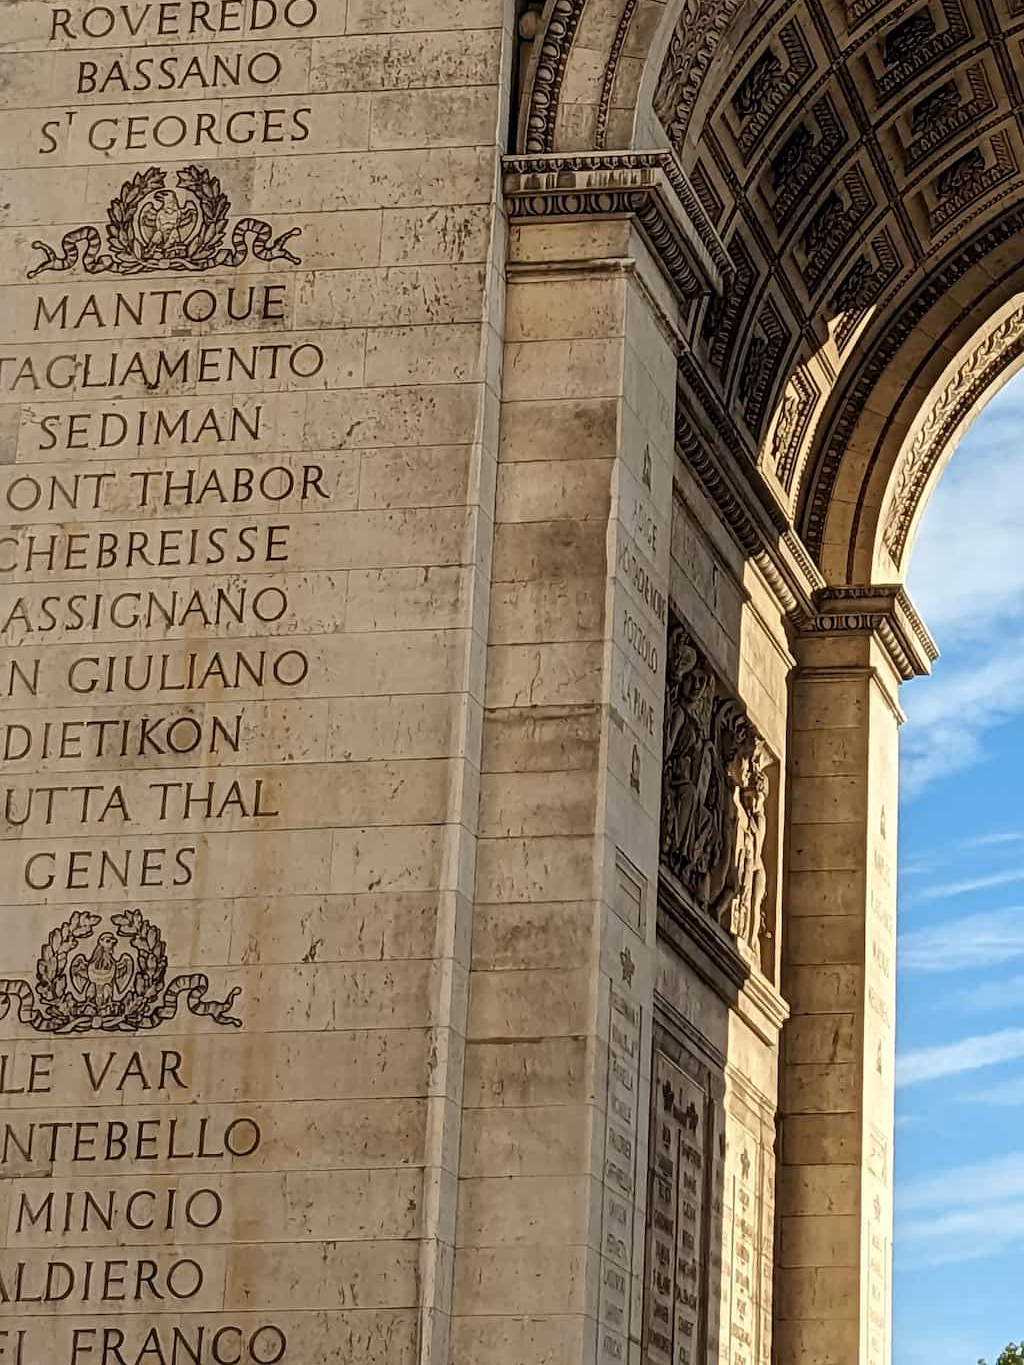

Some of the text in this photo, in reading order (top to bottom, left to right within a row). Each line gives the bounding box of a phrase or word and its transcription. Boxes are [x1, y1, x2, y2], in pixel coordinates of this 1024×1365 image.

[76, 52, 282, 94] BASSANO
[88, 108, 312, 152] GEORGES
[33, 284, 287, 331] MANTOUE
[39, 406, 262, 450] SEDIMAN
[130, 465, 330, 507] THABOR
[0, 525, 290, 572] CHEBREISSE
[68, 649, 309, 694] GIULIANO
[2, 716, 243, 761] DIETIKON
[150, 780, 279, 820] THAL
[24, 847, 195, 890] GENES
[0, 1050, 189, 1093] LE VAR
[16, 1189, 222, 1233] MINCIO
[71, 1325, 287, 1365] FRANCO
